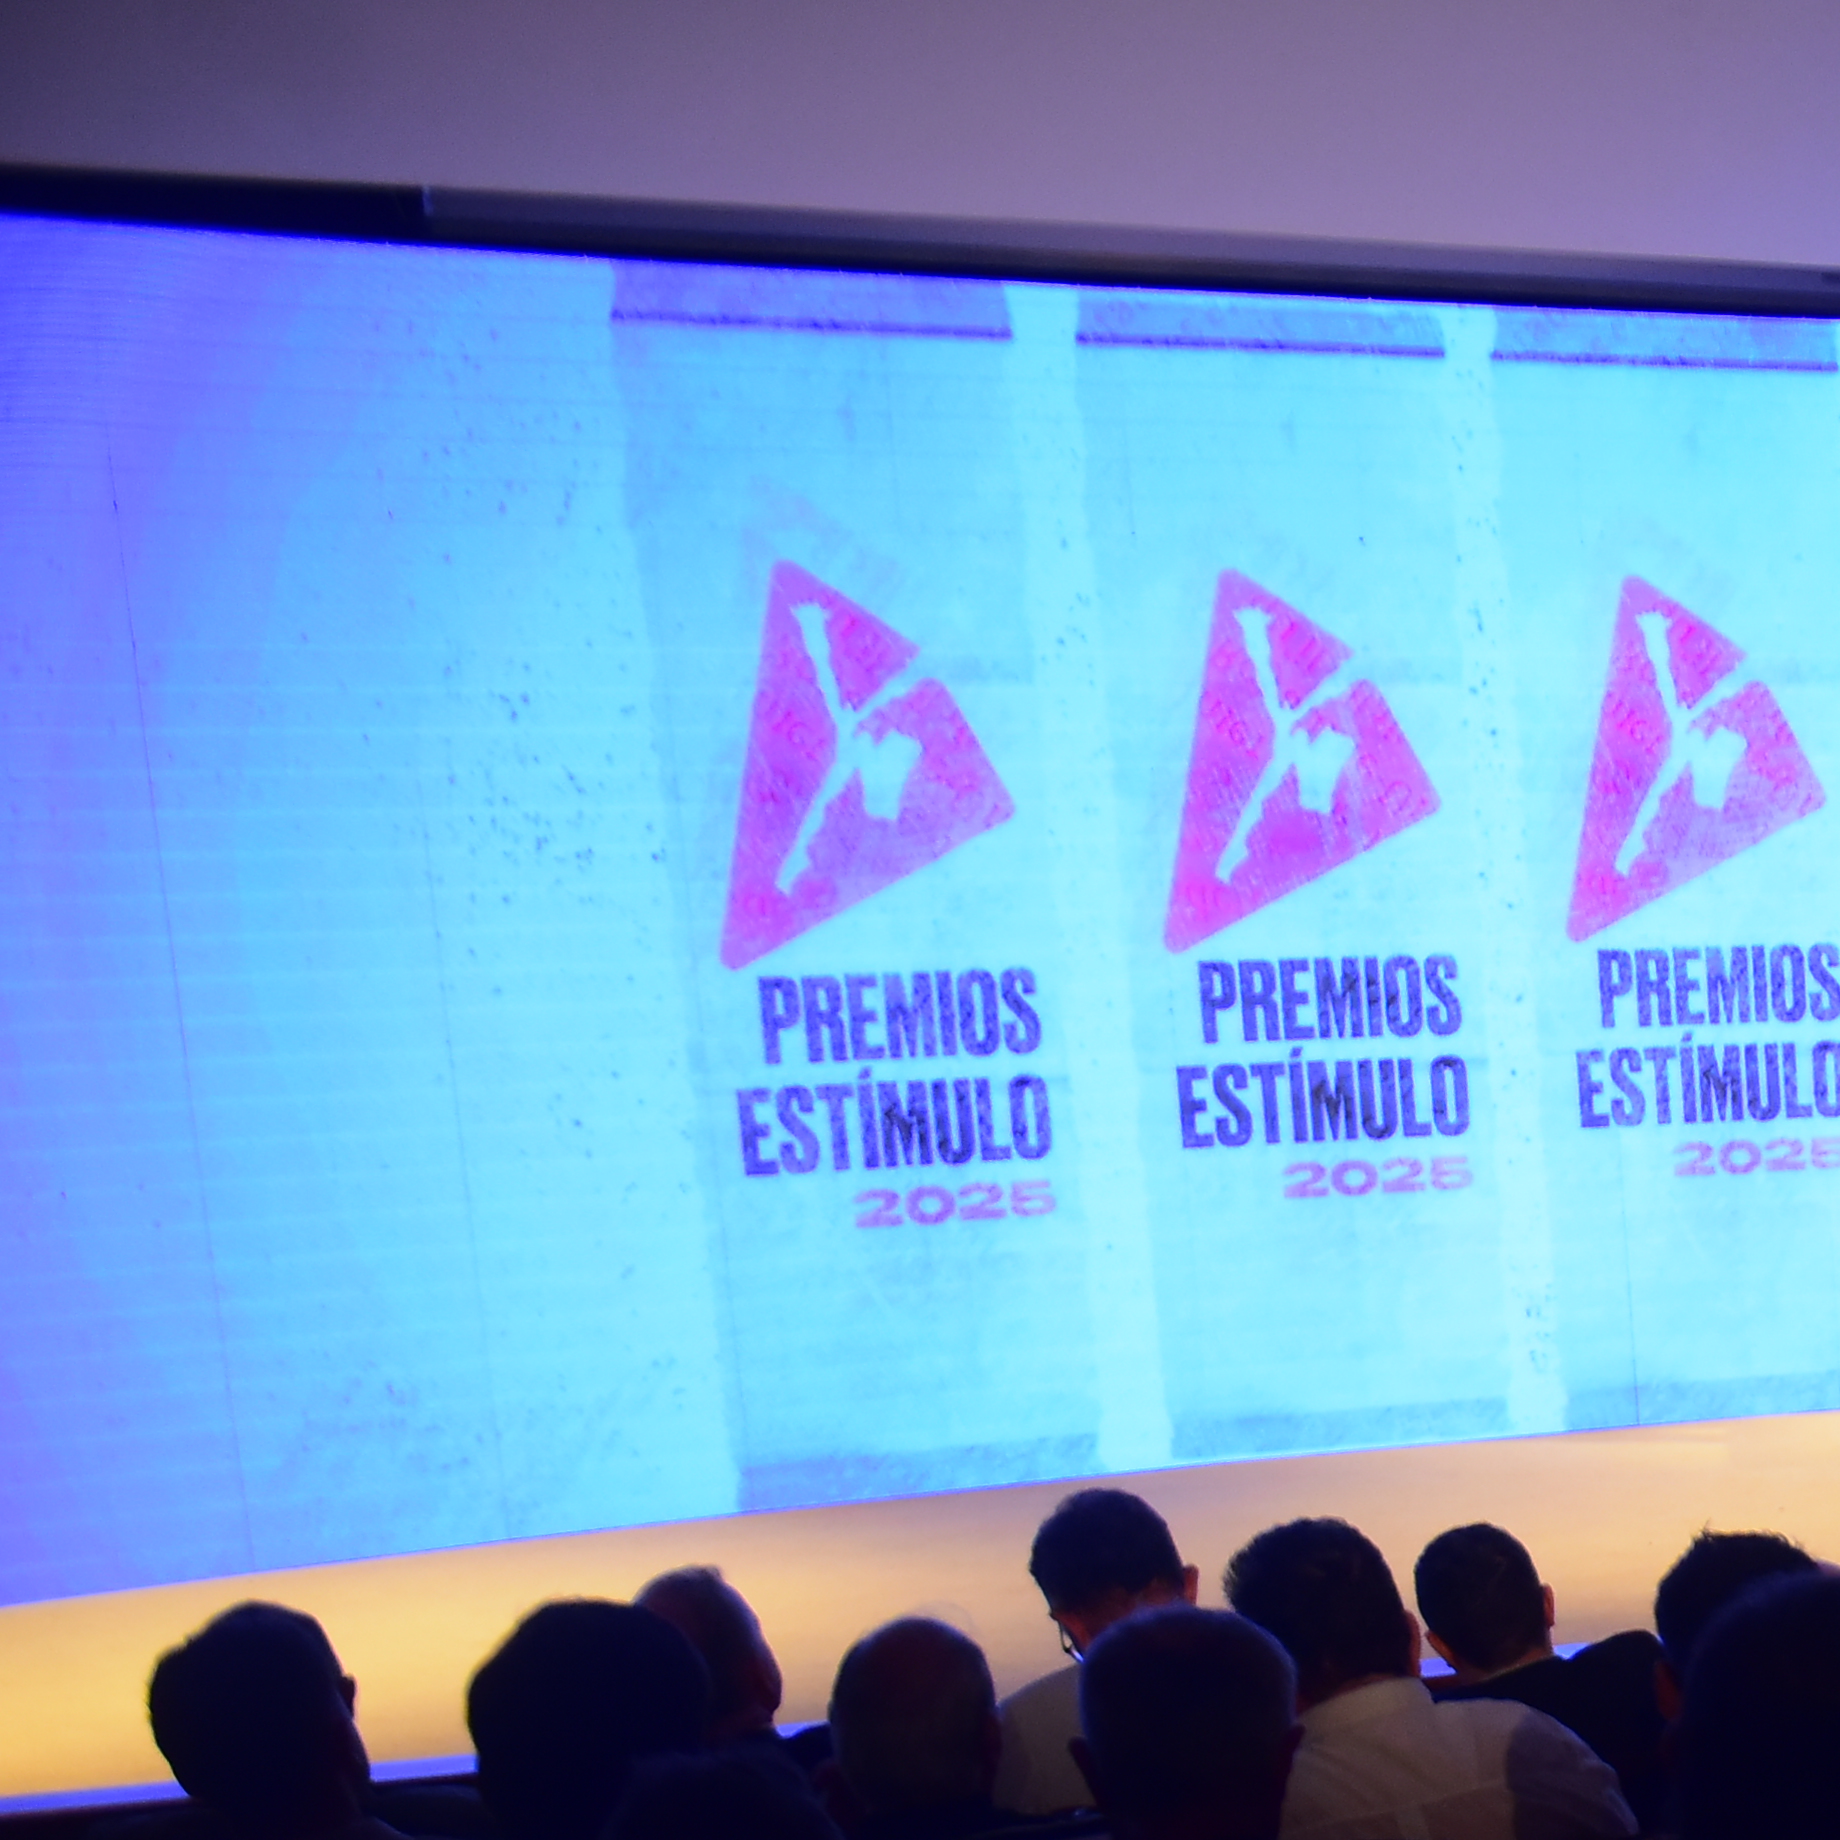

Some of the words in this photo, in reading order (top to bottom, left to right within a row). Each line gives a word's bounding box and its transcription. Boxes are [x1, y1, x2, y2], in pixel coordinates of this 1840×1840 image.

[757, 967, 1042, 1065] PREMIOS
[1198, 954, 1463, 1044] PREMIOS
[736, 1065, 1051, 1177] ESTÍMULO
[1175, 1046, 1470, 1149] ESTÍMULO
[854, 1180, 1056, 1228] 2025
[1283, 1156, 1472, 1199] 2025
